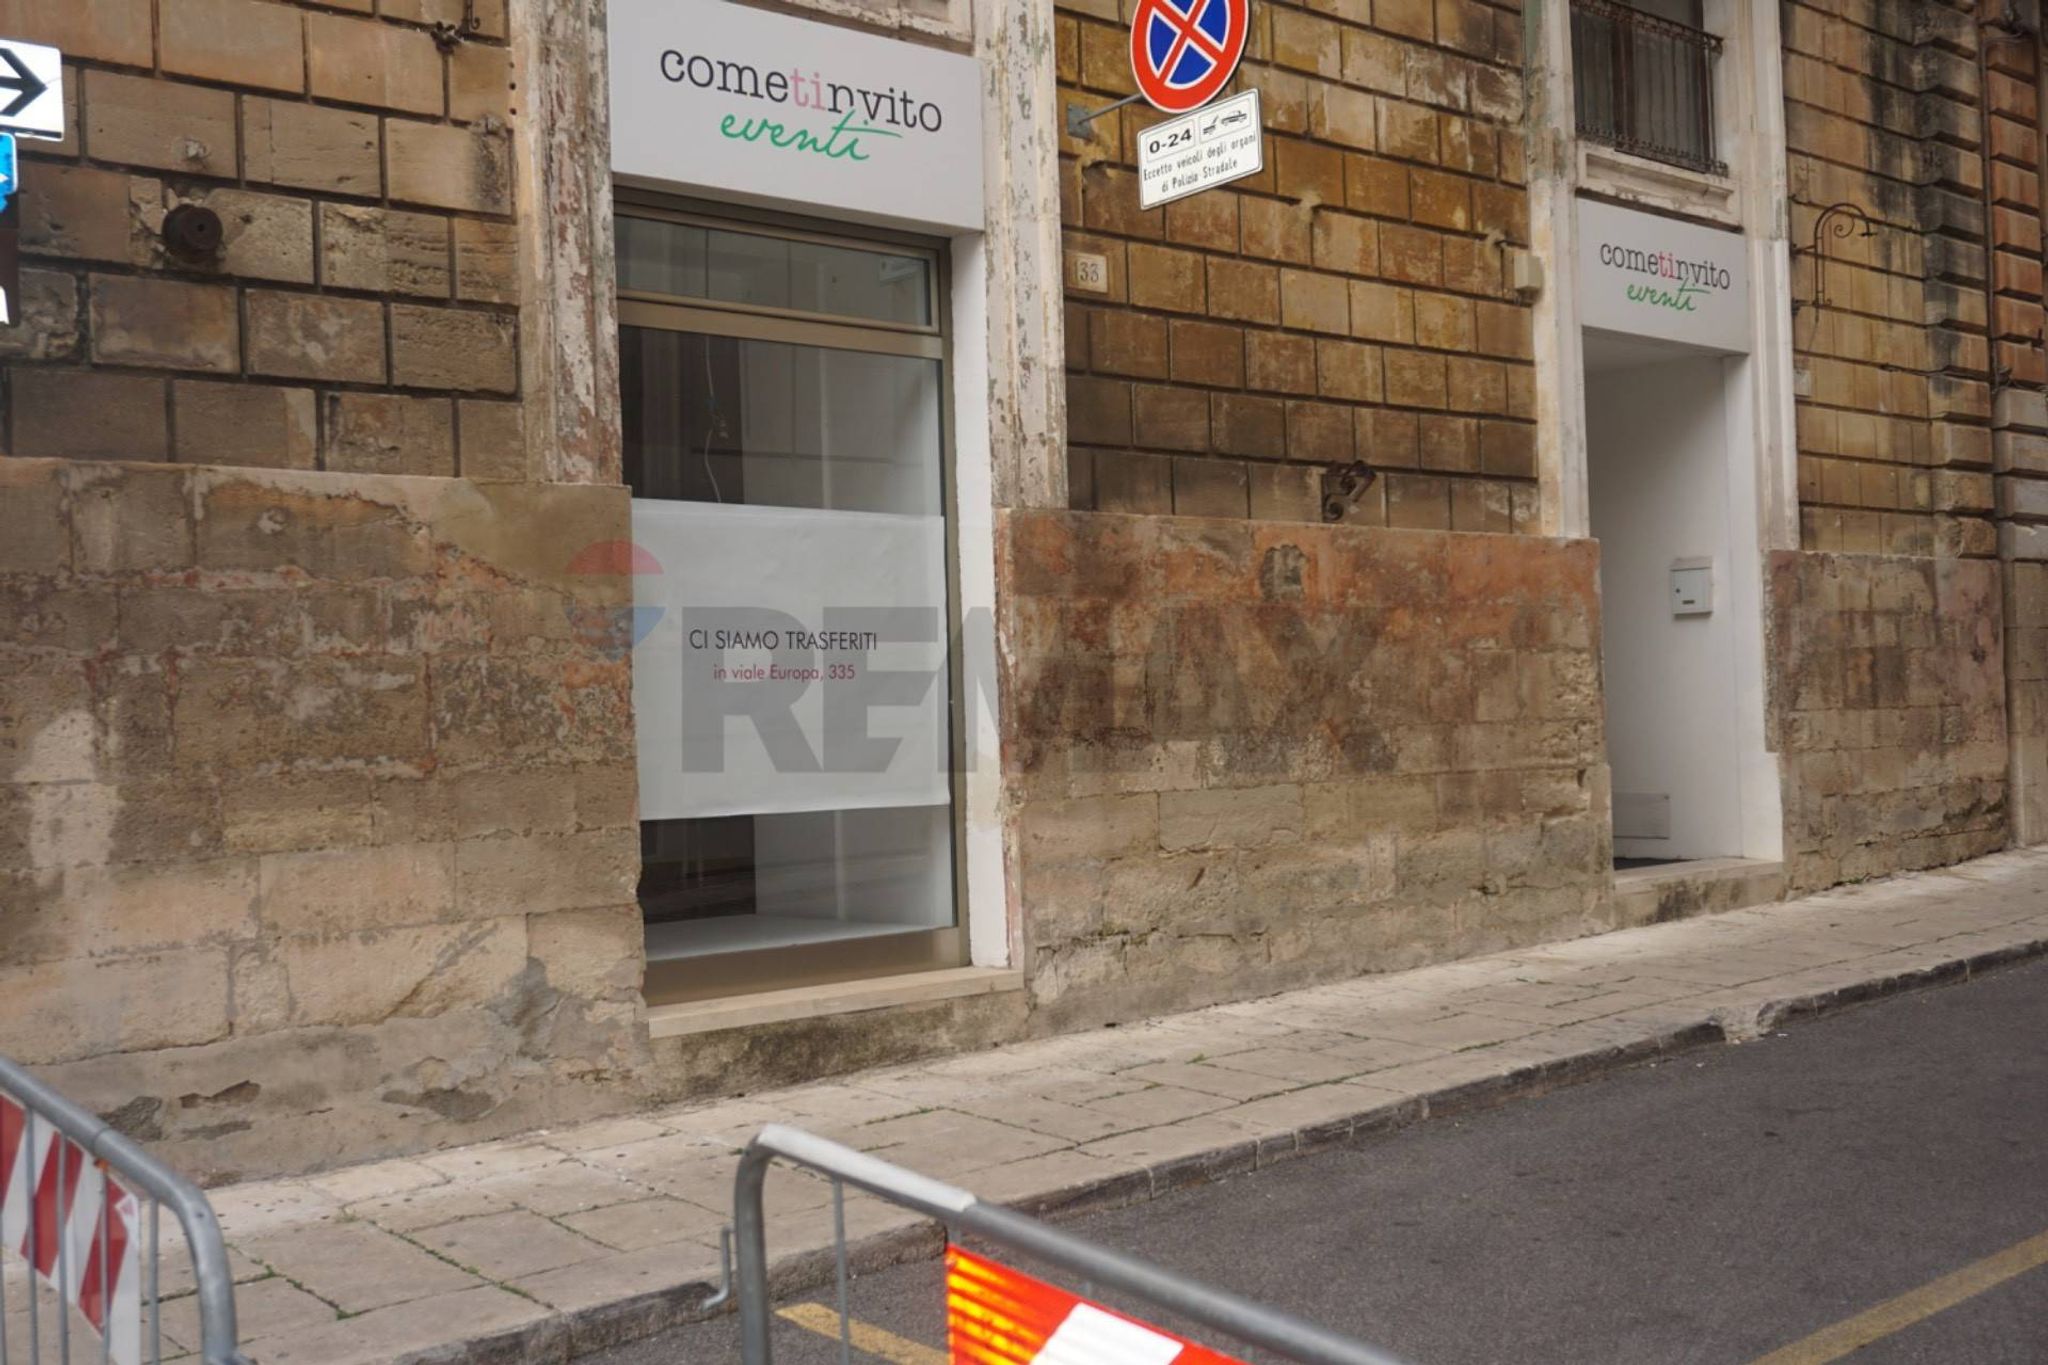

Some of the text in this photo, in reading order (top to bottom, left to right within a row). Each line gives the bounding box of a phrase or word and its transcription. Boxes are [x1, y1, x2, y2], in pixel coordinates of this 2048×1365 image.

[661, 50, 942, 132] cometinvito
[721, 110, 903, 160] eventi
[1149, 128, 1192, 153] 0-24
[1143, 133, 1256, 180] Eccetto veicoli degli organi
[1162, 158, 1238, 193] di Polizia Stradale
[1600, 243, 1730, 290] cometinvito
[1627, 277, 1711, 311] eventi
[689, 629, 877, 651] CI SIAMO TRASFERITI
[713, 664, 855, 684] in viale Europa, 335
